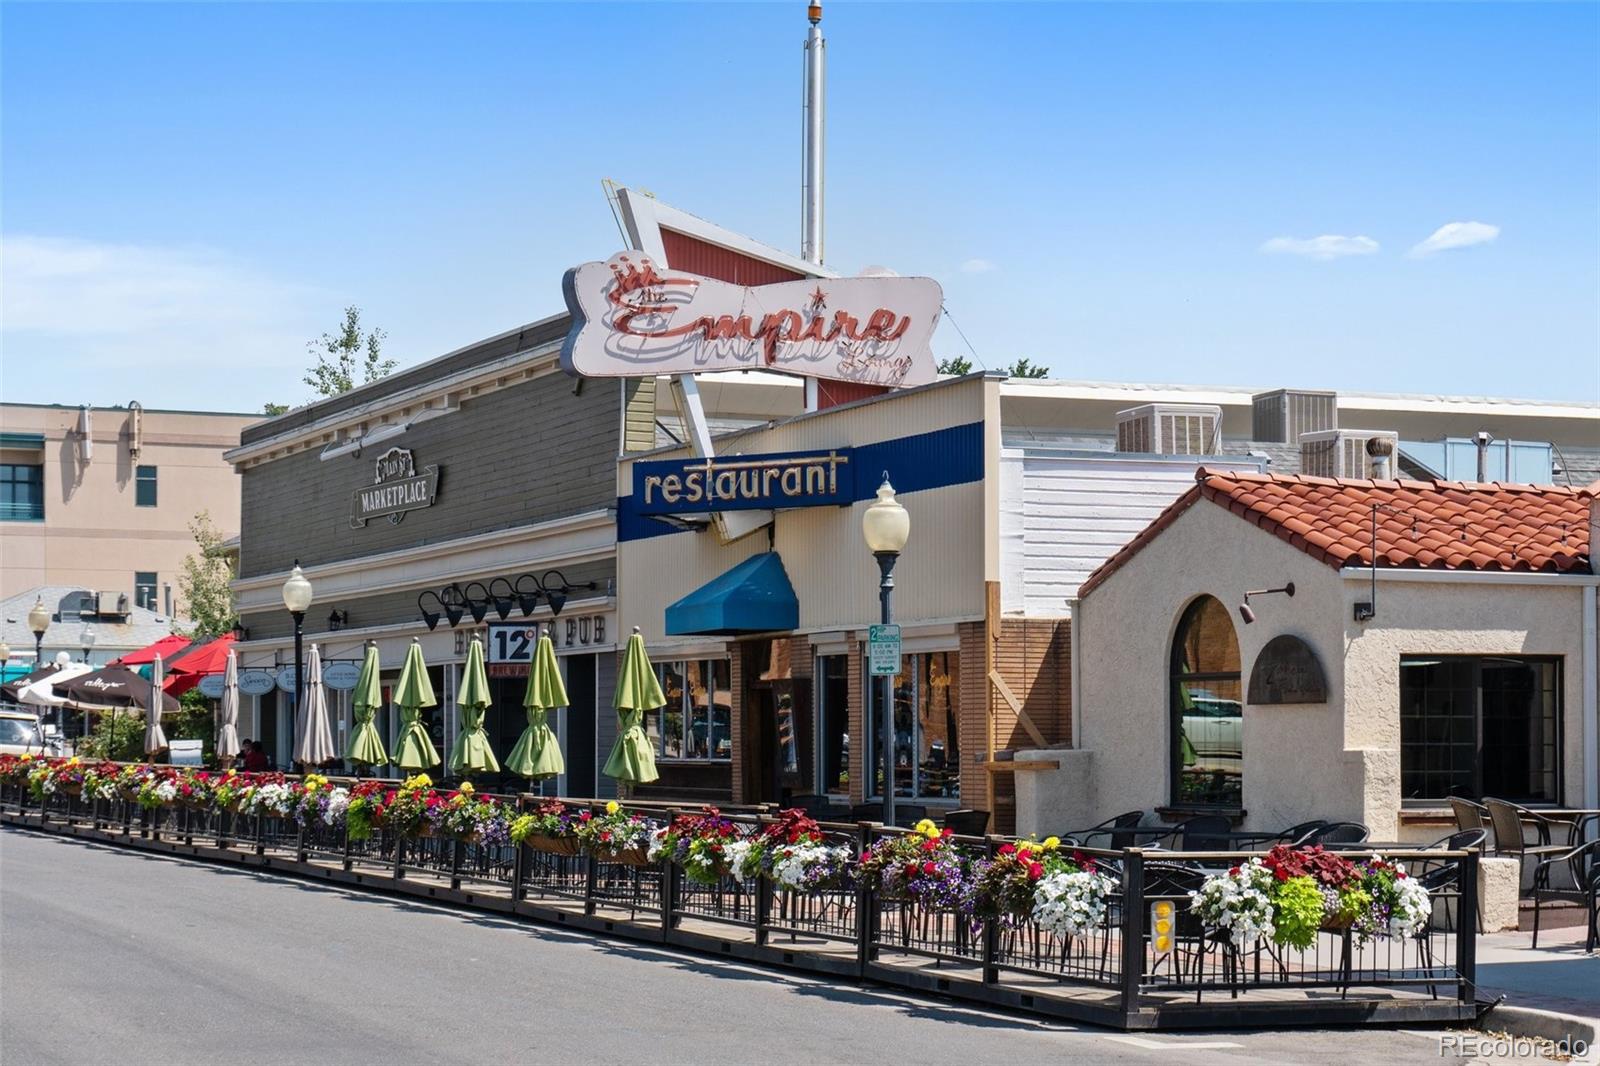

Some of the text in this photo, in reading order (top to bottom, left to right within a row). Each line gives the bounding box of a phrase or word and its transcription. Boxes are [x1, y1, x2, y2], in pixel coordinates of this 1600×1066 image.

[609, 272, 911, 365] Empire
[644, 451, 849, 505] restaurant
[361, 480, 427, 512] MARKETPLACE
[566, 615, 606, 646] PUB
[871, 627, 878, 641] 2
